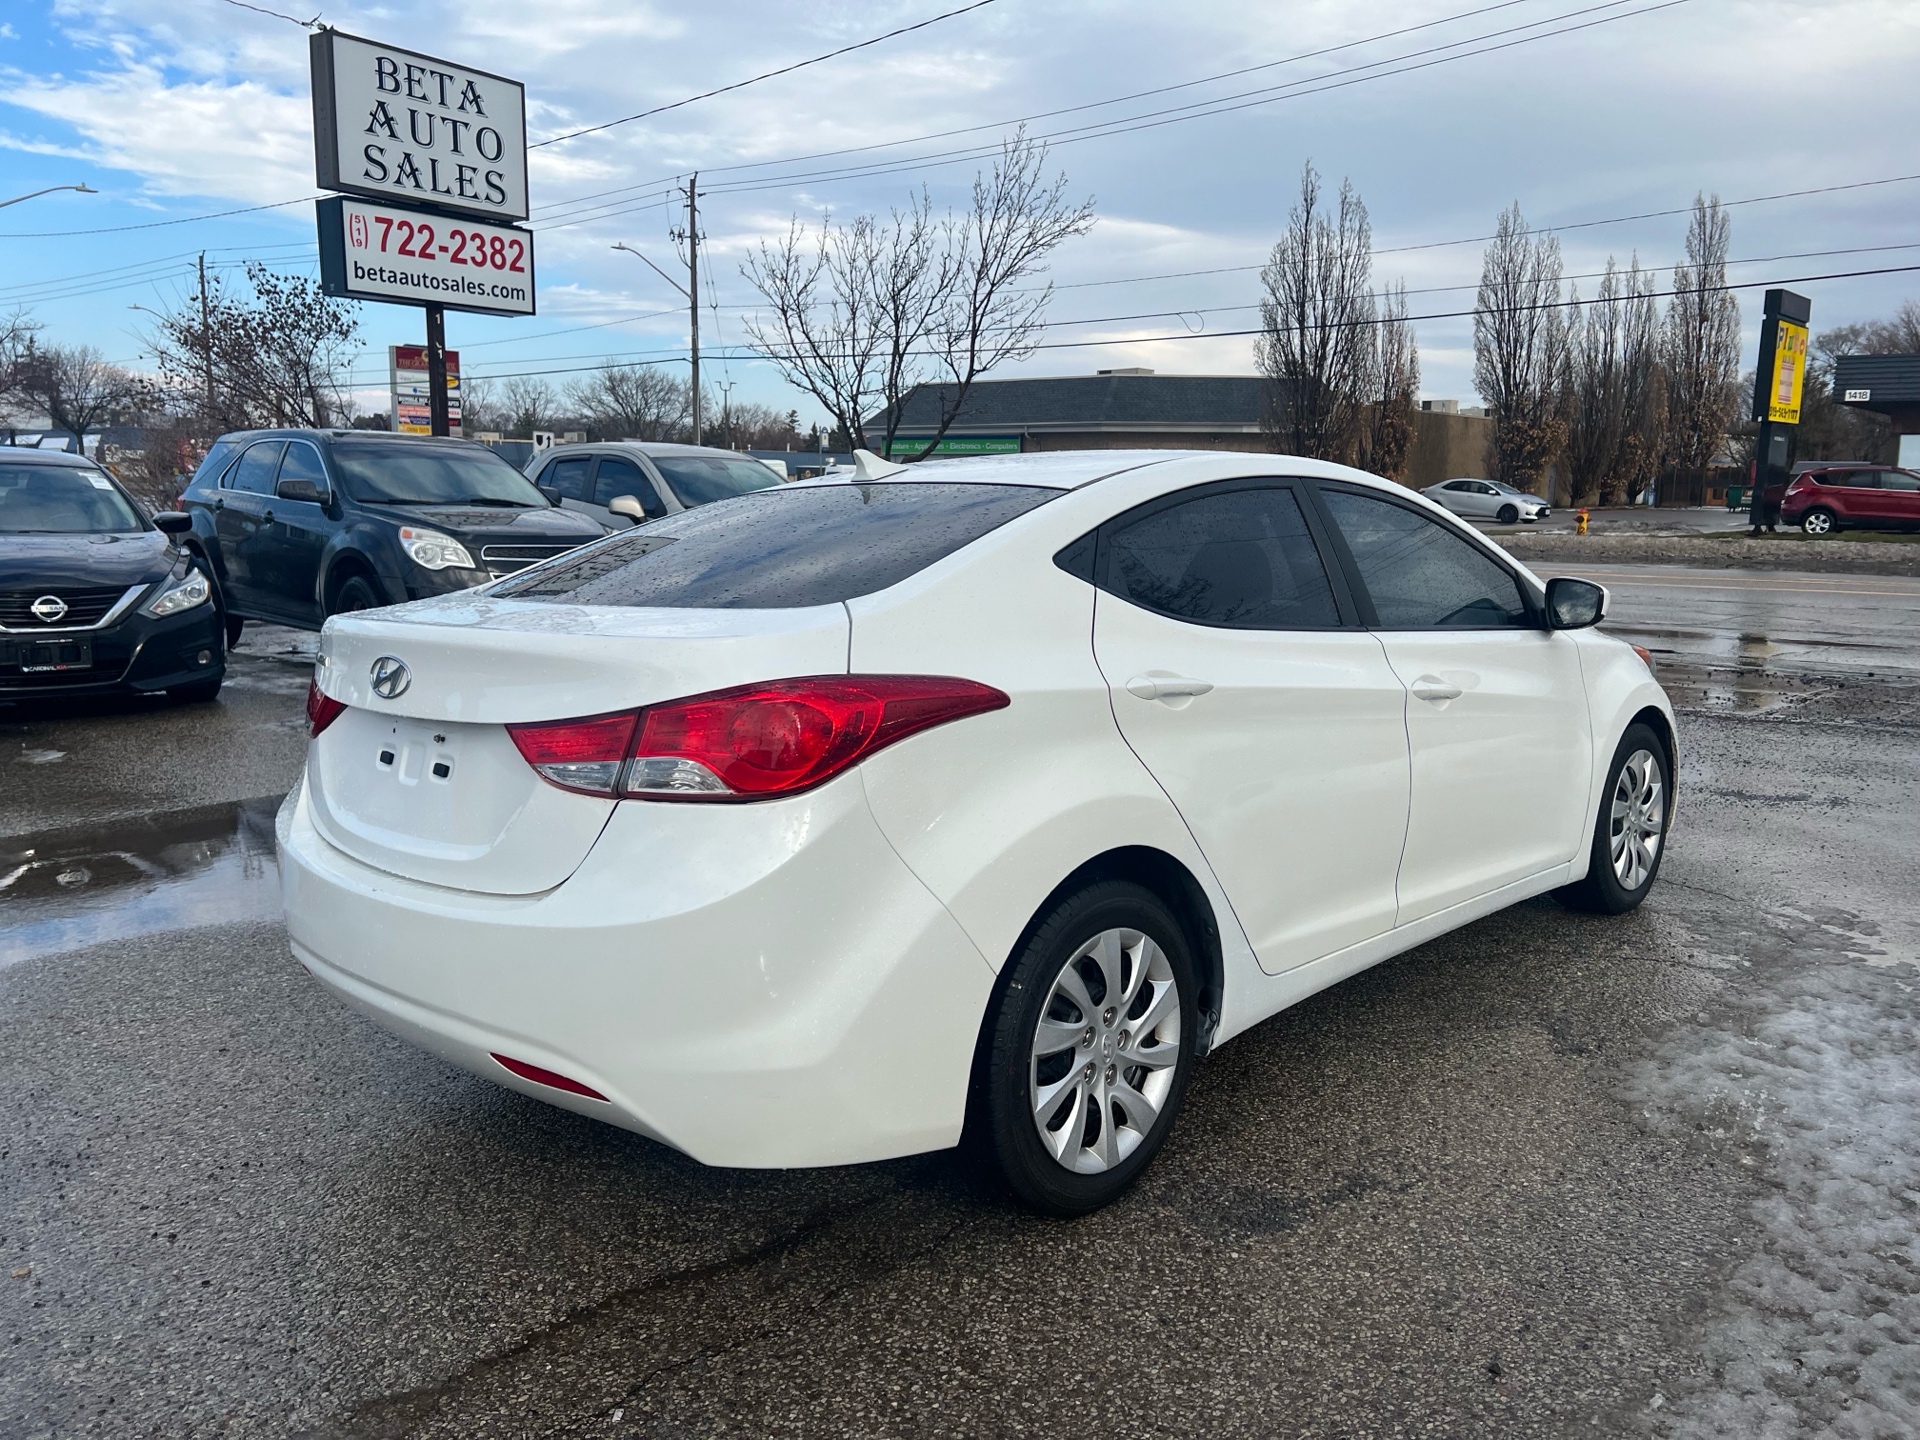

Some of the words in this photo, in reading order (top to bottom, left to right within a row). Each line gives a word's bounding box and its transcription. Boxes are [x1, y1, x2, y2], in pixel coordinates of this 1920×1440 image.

[375, 56, 488, 118] BETA
[363, 99, 505, 163] AUTO
[363, 144, 508, 206] SALES
[374, 215, 526, 273] 722-2382
[353, 260, 526, 301] betaautosales.com
[1848, 391, 1868, 400] 1418
[950, 442, 981, 450] Electronics
[985, 442, 1018, 451] Computers
